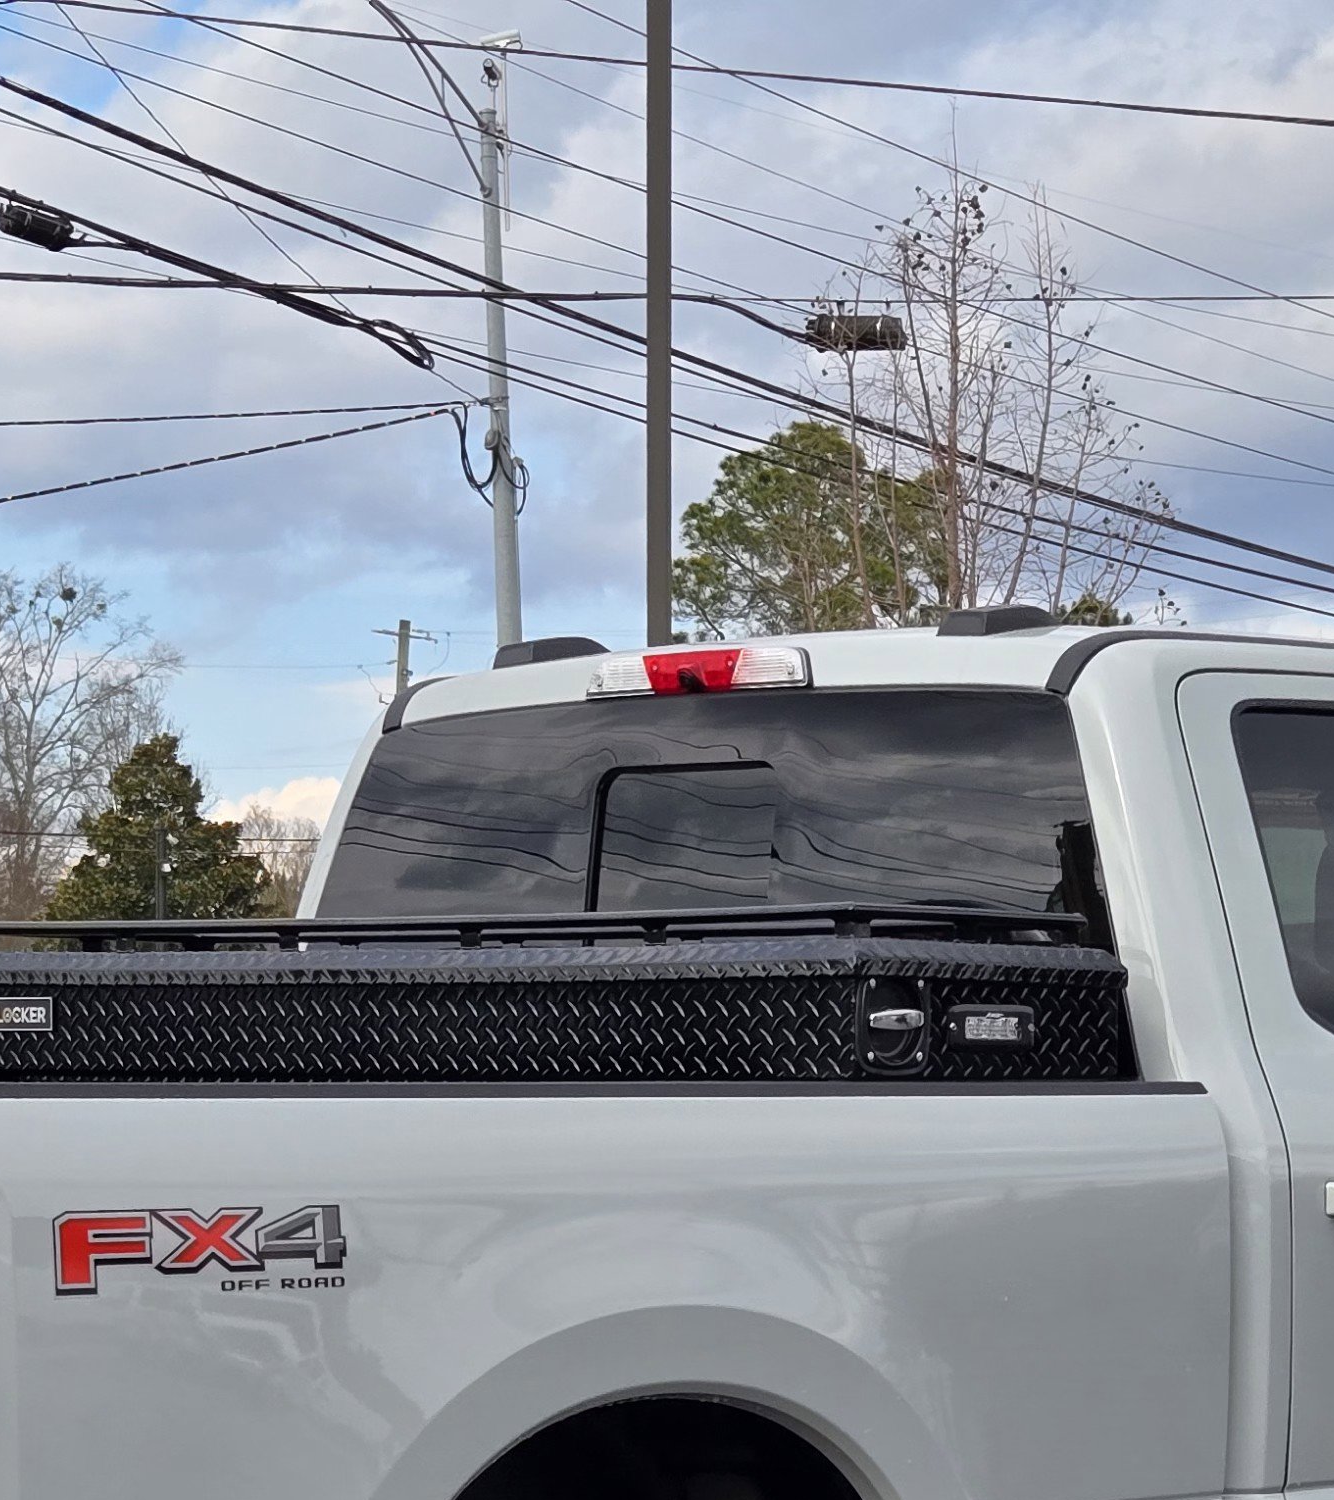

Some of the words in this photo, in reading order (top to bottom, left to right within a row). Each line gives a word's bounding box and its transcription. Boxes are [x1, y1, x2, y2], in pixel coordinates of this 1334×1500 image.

[52, 1205, 347, 1296] FX4
[220, 1278, 271, 1292] OFF
[279, 1276, 346, 1290] ROAD
